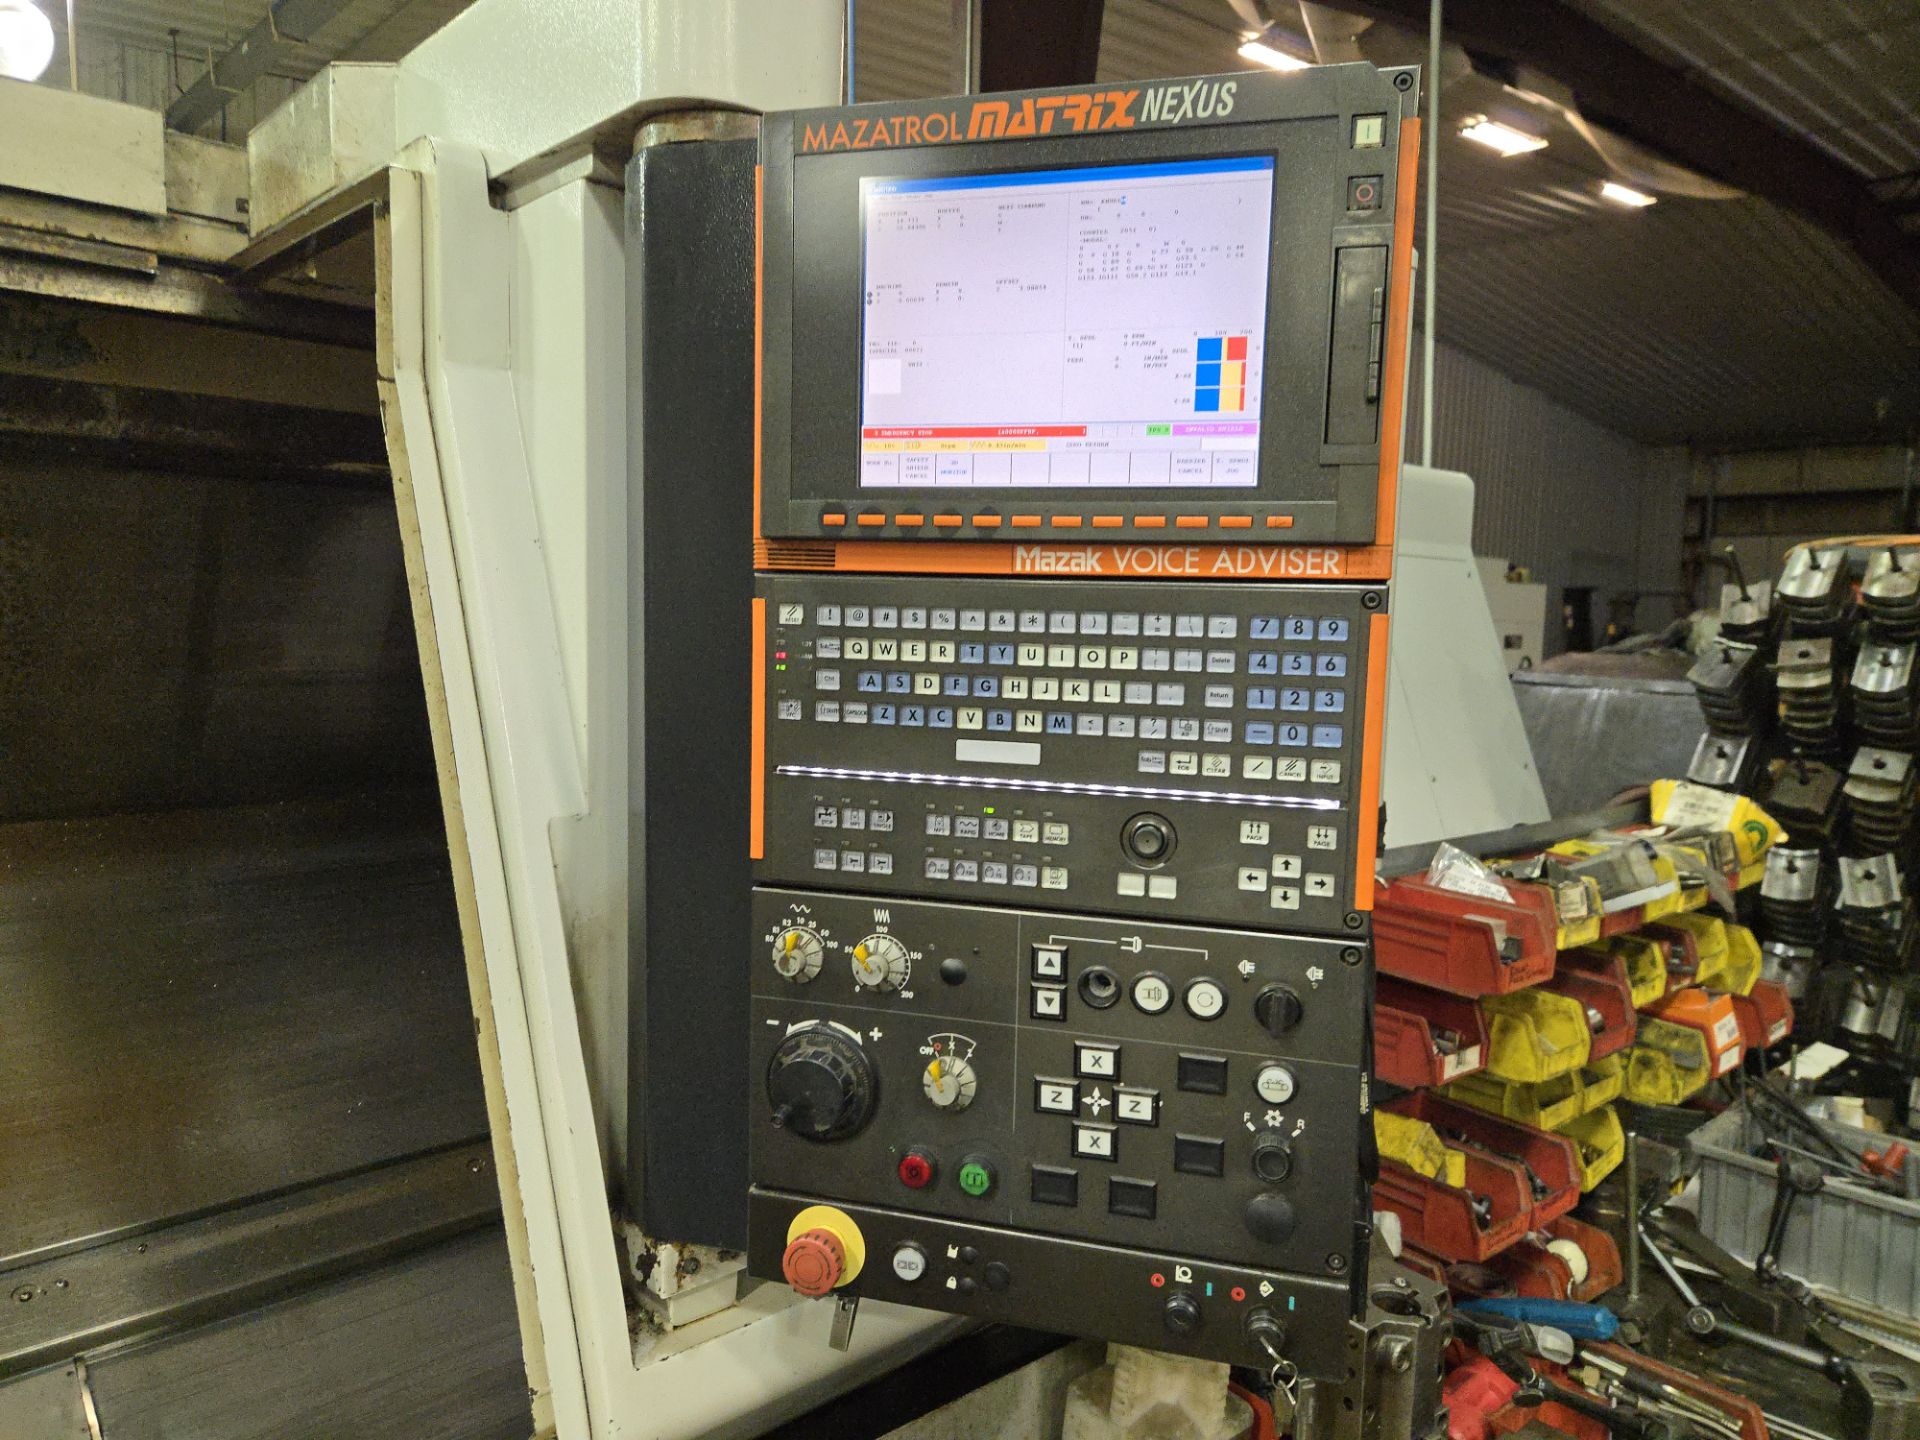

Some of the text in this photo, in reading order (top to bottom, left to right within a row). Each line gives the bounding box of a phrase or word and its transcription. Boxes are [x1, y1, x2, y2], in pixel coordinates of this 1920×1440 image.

[802, 79, 1238, 152] MAZATROL MATRIX NEXUS
[1015, 546, 1103, 572] Mazak
[1112, 547, 1200, 574] VOICE
[1211, 547, 1340, 575] ADVISER
[853, 610, 864, 622] @
[883, 612, 890, 622] #
[912, 612, 918, 622] $
[939, 614, 950, 624] %
[999, 615, 1006, 625] &
[1260, 619, 1339, 636] 7 8 9
[852, 642, 863, 655] Q
[879, 643, 893, 655] W
[911, 644, 918, 656] E
[939, 645, 947, 657] R
[969, 646, 977, 658] T
[998, 647, 1007, 659] Y
[1027, 648, 1037, 661] U
[1087, 650, 1099, 662] O
[1121, 651, 1129, 664] P
[1257, 655, 1336, 672] 4 5 6
[866, 675, 1111, 697] A S D F G H J K L
[1290, 690, 1300, 706] 2
[1324, 692, 1334, 707] 3
[881, 707, 889, 720] Z
[908, 709, 917, 721] X
[936, 711, 946, 722] C
[966, 711, 975, 723] V
[996, 713, 1004, 725] B
[1024, 714, 1035, 727] N
[1053, 716, 1066, 729] M
[1287, 726, 1298, 740] 0
[782, 919, 791, 927] R2
[797, 917, 805, 925] 10
[821, 929, 830, 937] 50
[876, 925, 888, 933] 100
[826, 941, 839, 949] 100
[910, 951, 923, 960] 150
[901, 990, 914, 999] 200
[919, 1045, 934, 1055] OFF
[1091, 1055, 1102, 1068] X
[1051, 1091, 1141, 1113] Z Z
[1090, 1136, 1100, 1148] X
